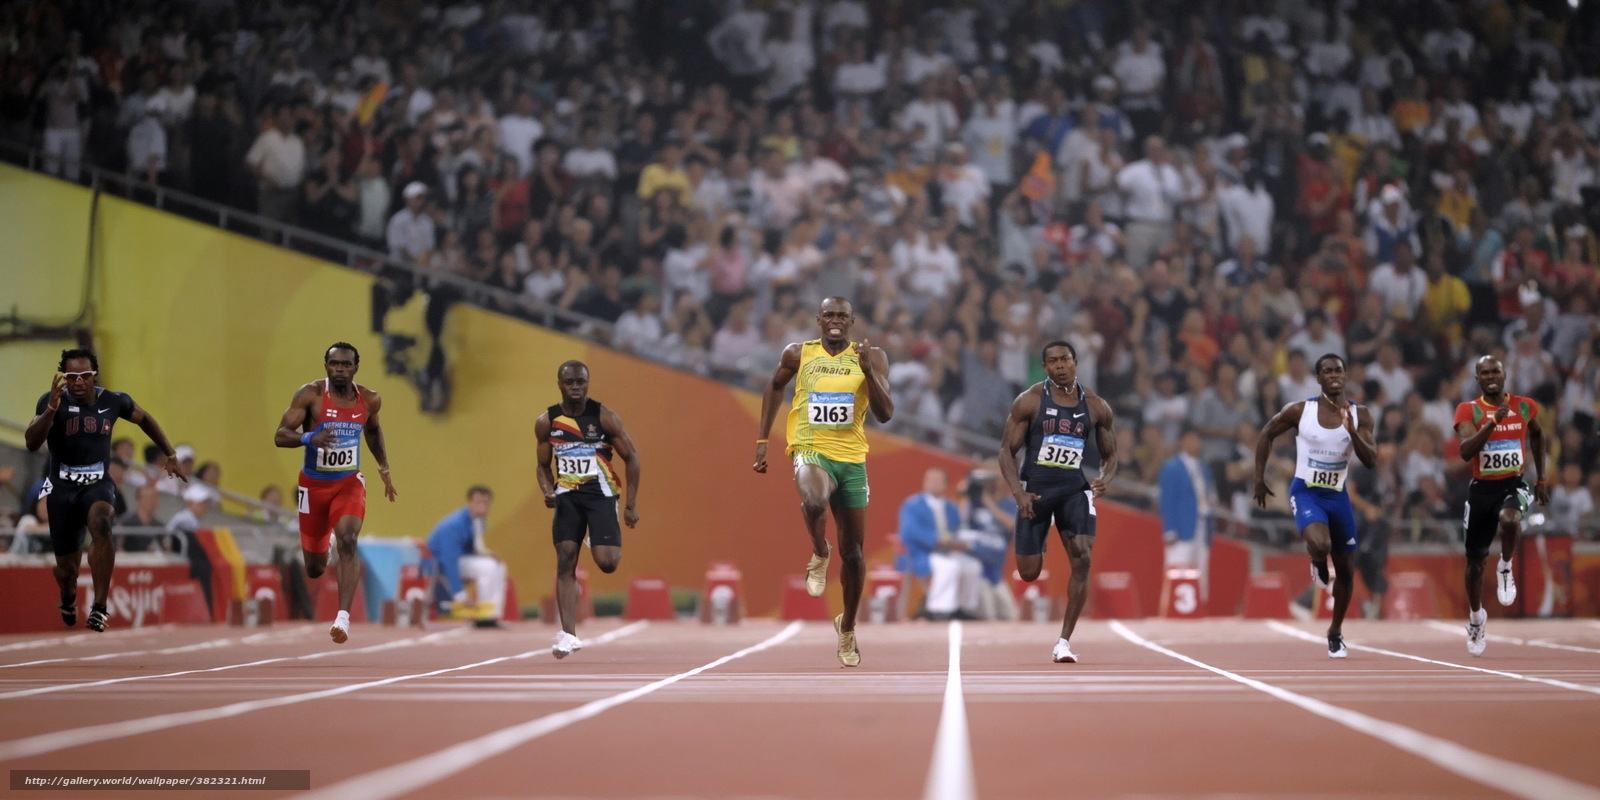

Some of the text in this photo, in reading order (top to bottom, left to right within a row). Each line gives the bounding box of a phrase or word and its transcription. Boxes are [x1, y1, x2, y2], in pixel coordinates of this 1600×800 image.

[809, 363, 851, 376] jamaica
[813, 406, 848, 422] 2163
[66, 416, 111, 436] USA
[323, 422, 362, 431] NETHERLANDS
[330, 428, 355, 436] ANTILLES
[1043, 418, 1084, 437] USA
[1507, 422, 1522, 431] NEVIS
[322, 450, 353, 467] 1003
[1044, 446, 1078, 465] 3152
[1309, 448, 1328, 456] GREAT
[562, 459, 591, 474] 3317
[1483, 452, 1520, 469] 2868
[1313, 470, 1339, 487] 1813
[1174, 583, 1197, 615] 3
